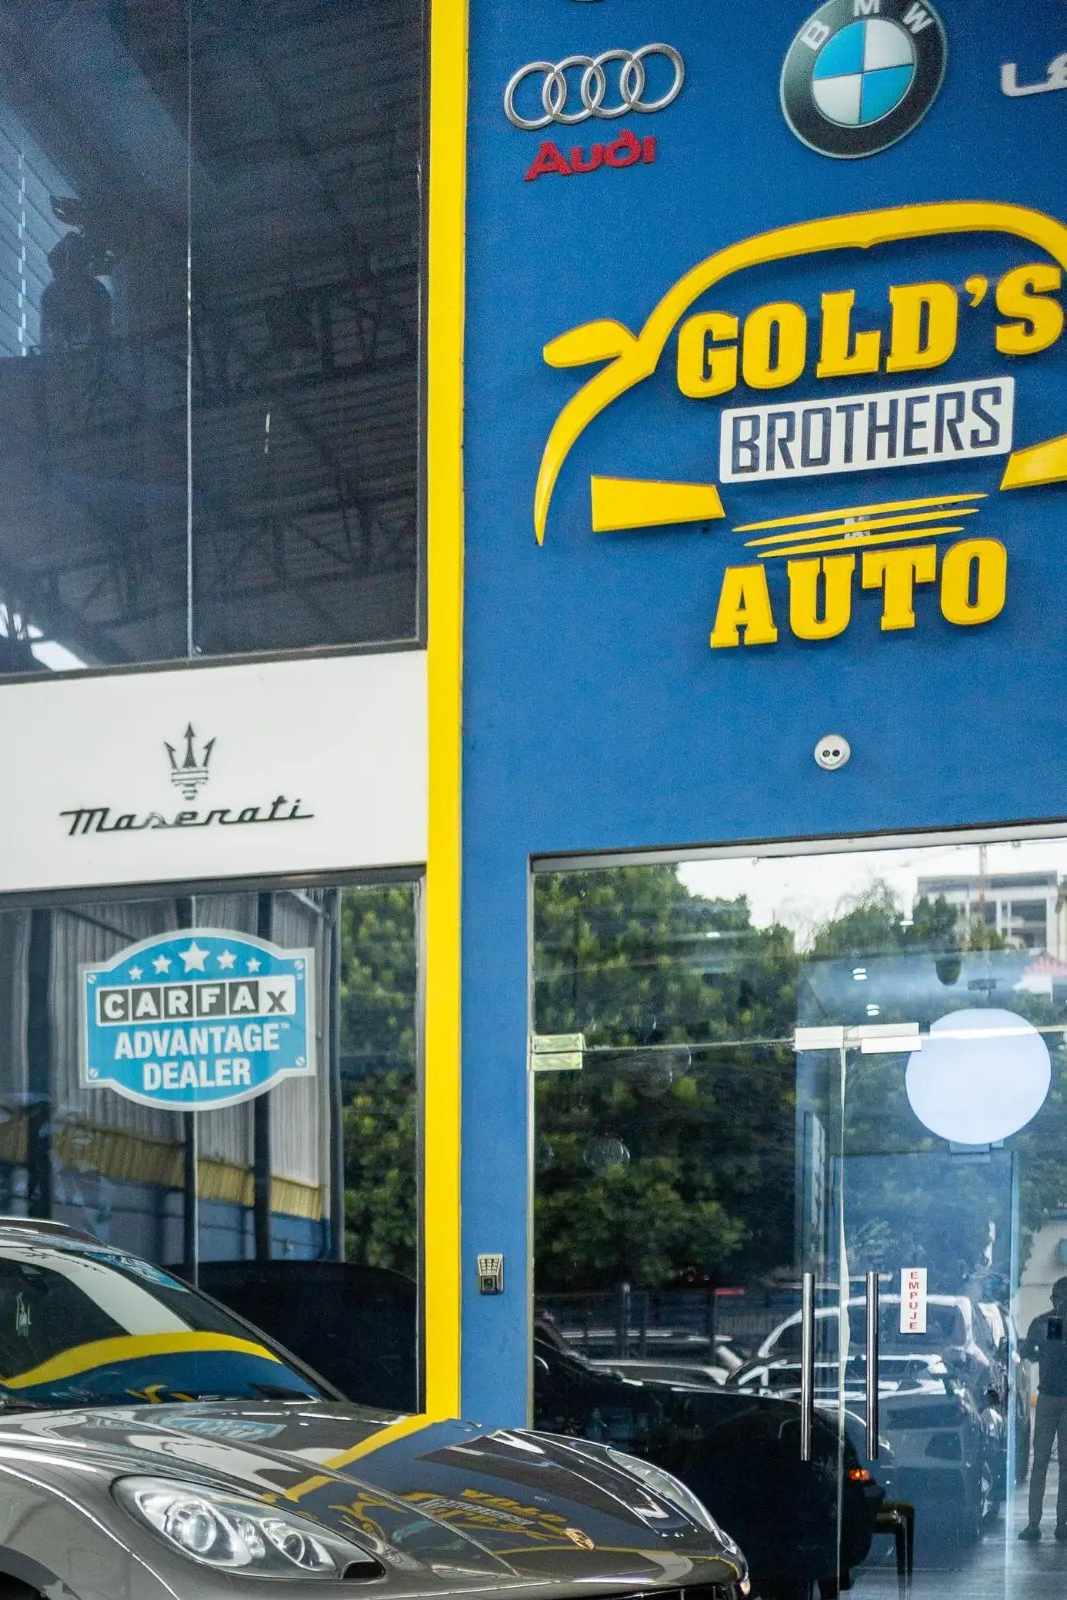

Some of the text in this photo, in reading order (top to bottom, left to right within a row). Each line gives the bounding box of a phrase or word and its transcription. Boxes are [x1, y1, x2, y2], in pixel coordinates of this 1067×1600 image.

[801, 0, 934, 51] BMW
[524, 129, 656, 181] Audi
[677, 263, 1065, 399] GOLD'S
[731, 386, 1002, 475] BROTHERS
[710, 537, 1007, 648] AUTO
[59, 795, 314, 836] Maserati
[103, 985, 287, 1019] CARFAX
[143, 1058, 252, 1091] DEALER
[908, 1271, 919, 1330] EMPUJE
